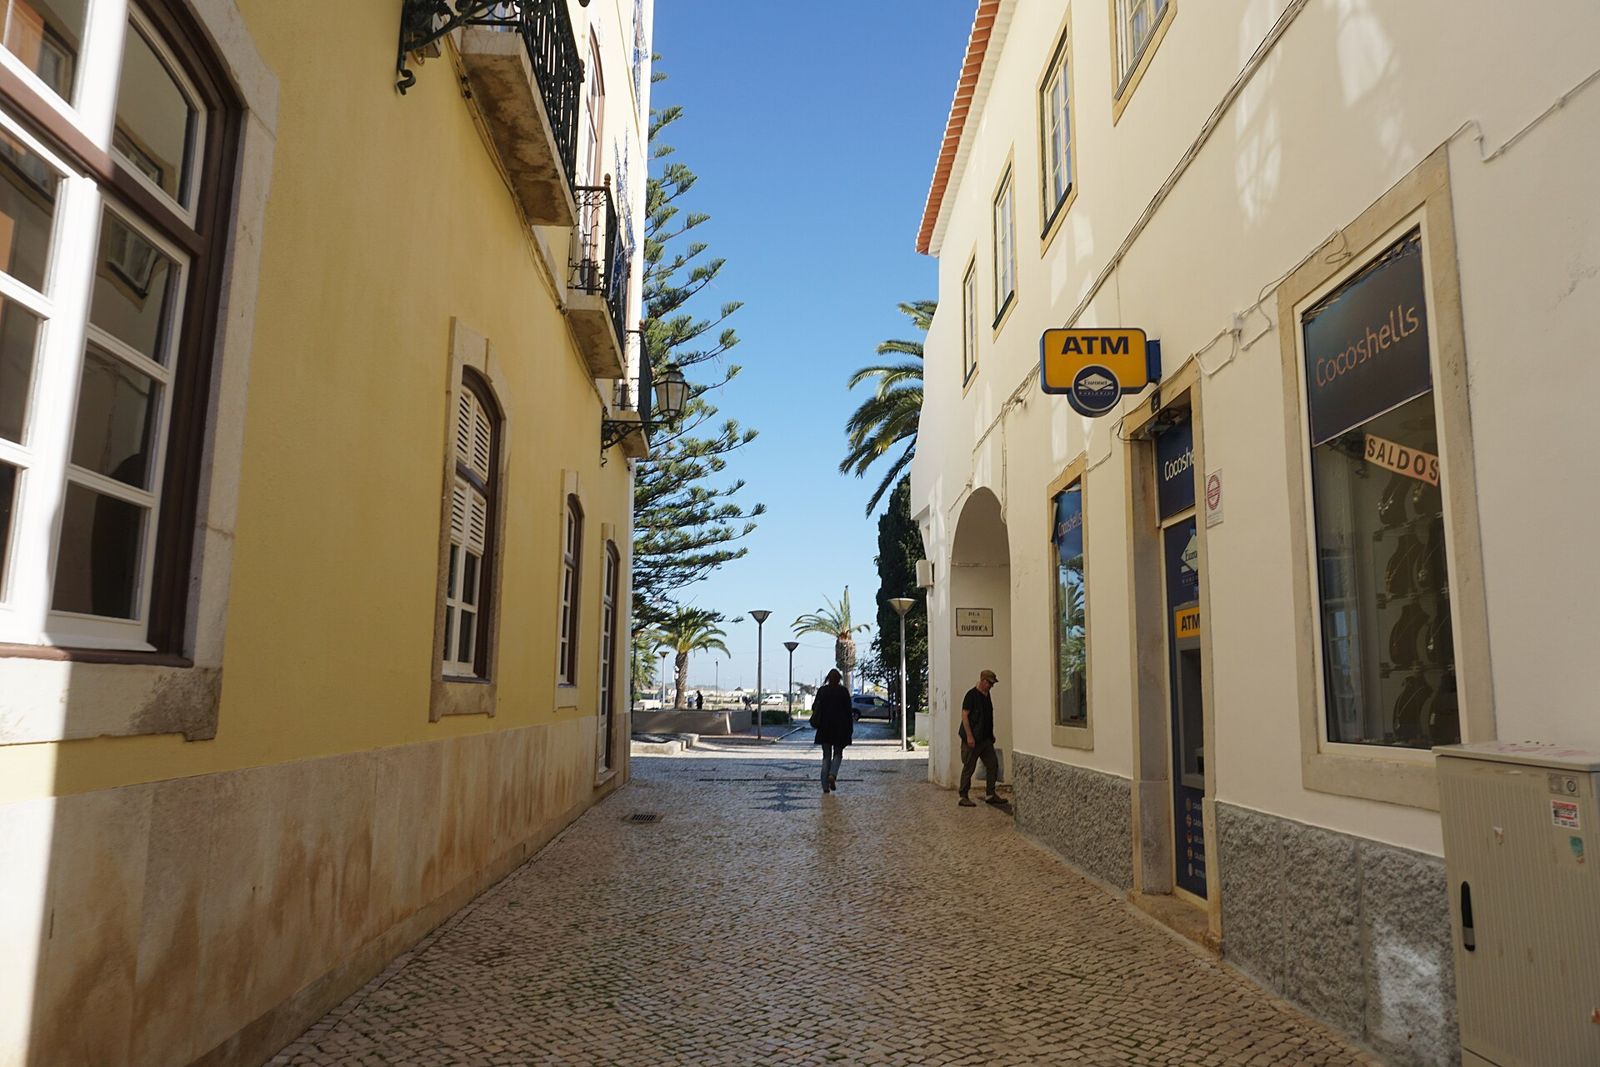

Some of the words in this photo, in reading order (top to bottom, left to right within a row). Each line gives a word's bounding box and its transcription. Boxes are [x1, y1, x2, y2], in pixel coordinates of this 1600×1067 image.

[1061, 336, 1129, 355] ATM
[1315, 304, 1420, 387] Cocoshells
[1367, 438, 1440, 481] SALDOS
[1181, 613, 1200, 632] ATM
